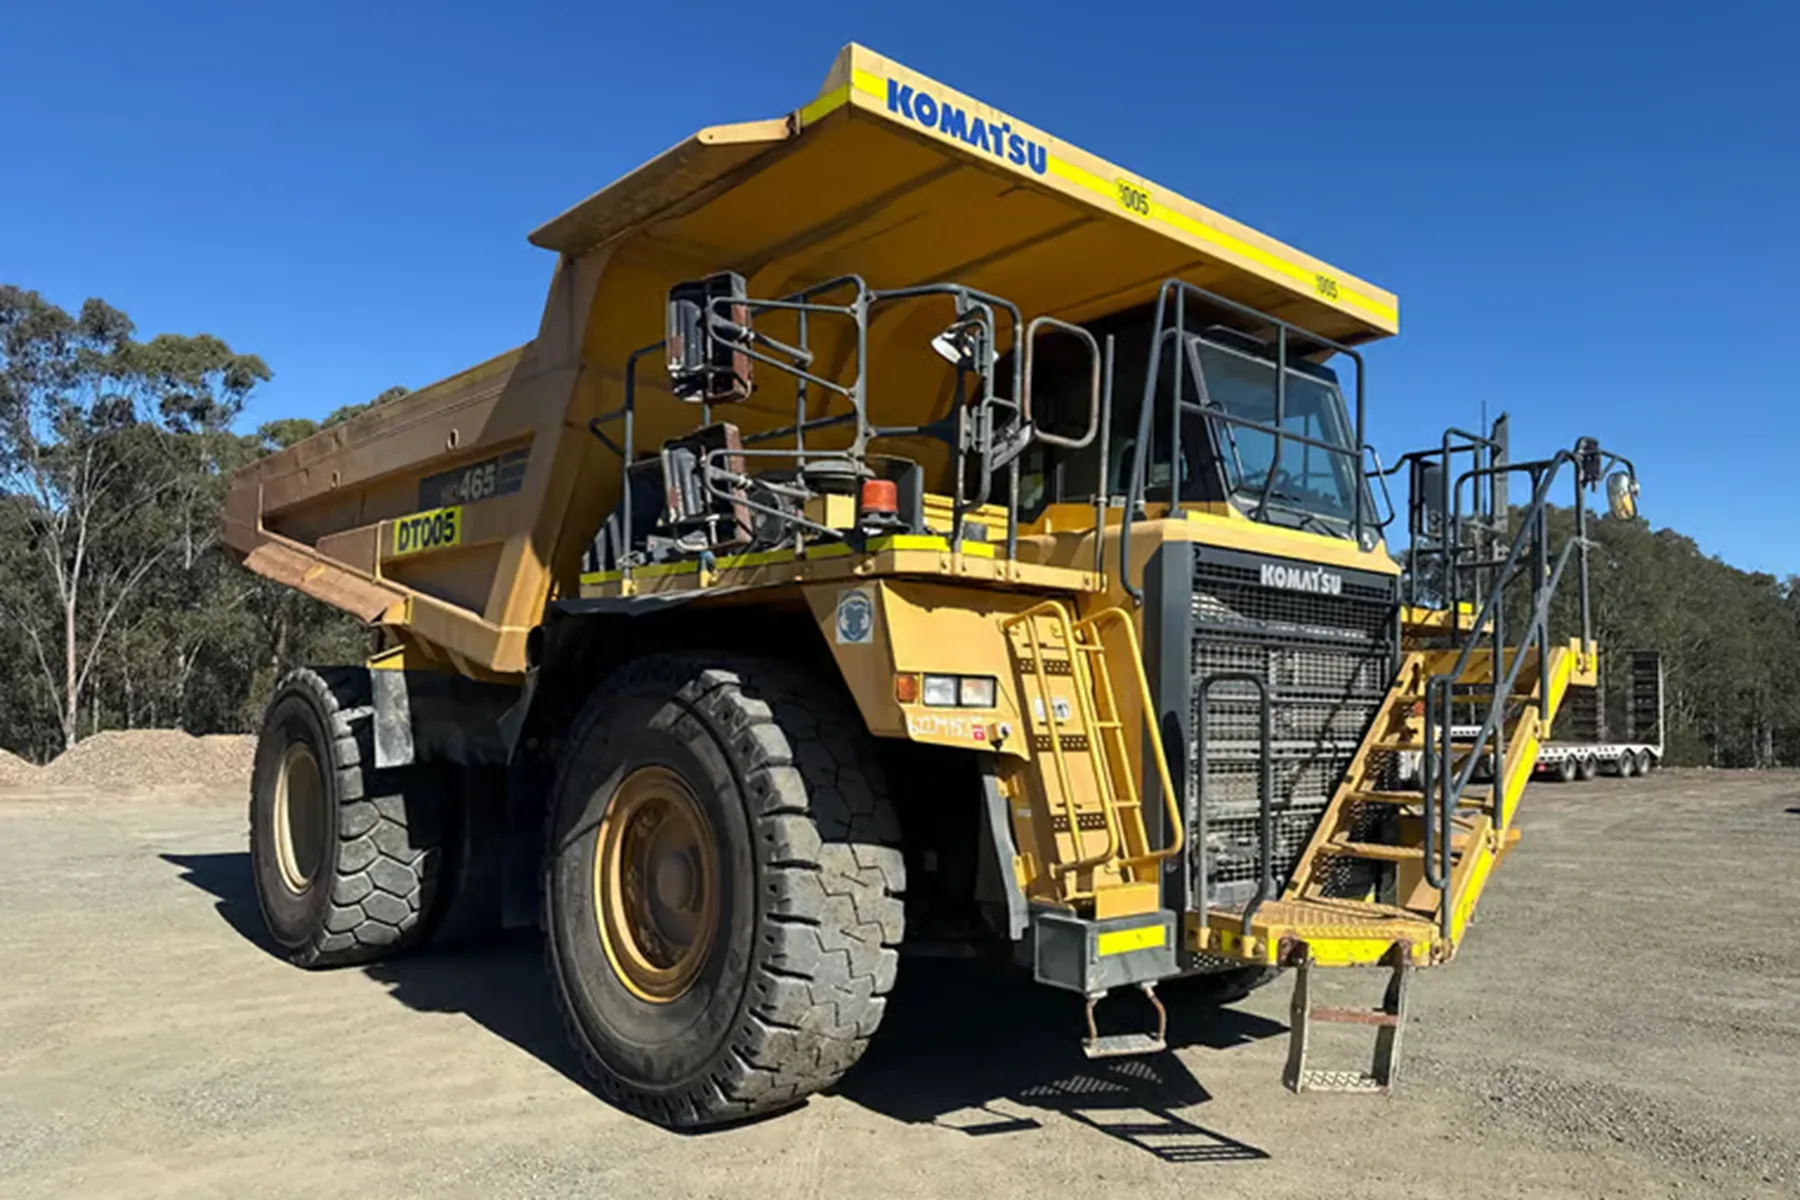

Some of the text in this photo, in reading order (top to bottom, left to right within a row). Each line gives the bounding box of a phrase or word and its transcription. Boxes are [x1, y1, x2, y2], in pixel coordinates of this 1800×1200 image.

[887, 77, 1047, 175] KOMATSU
[398, 511, 455, 551] DT005
[1261, 564, 1342, 595] KOMATSU
